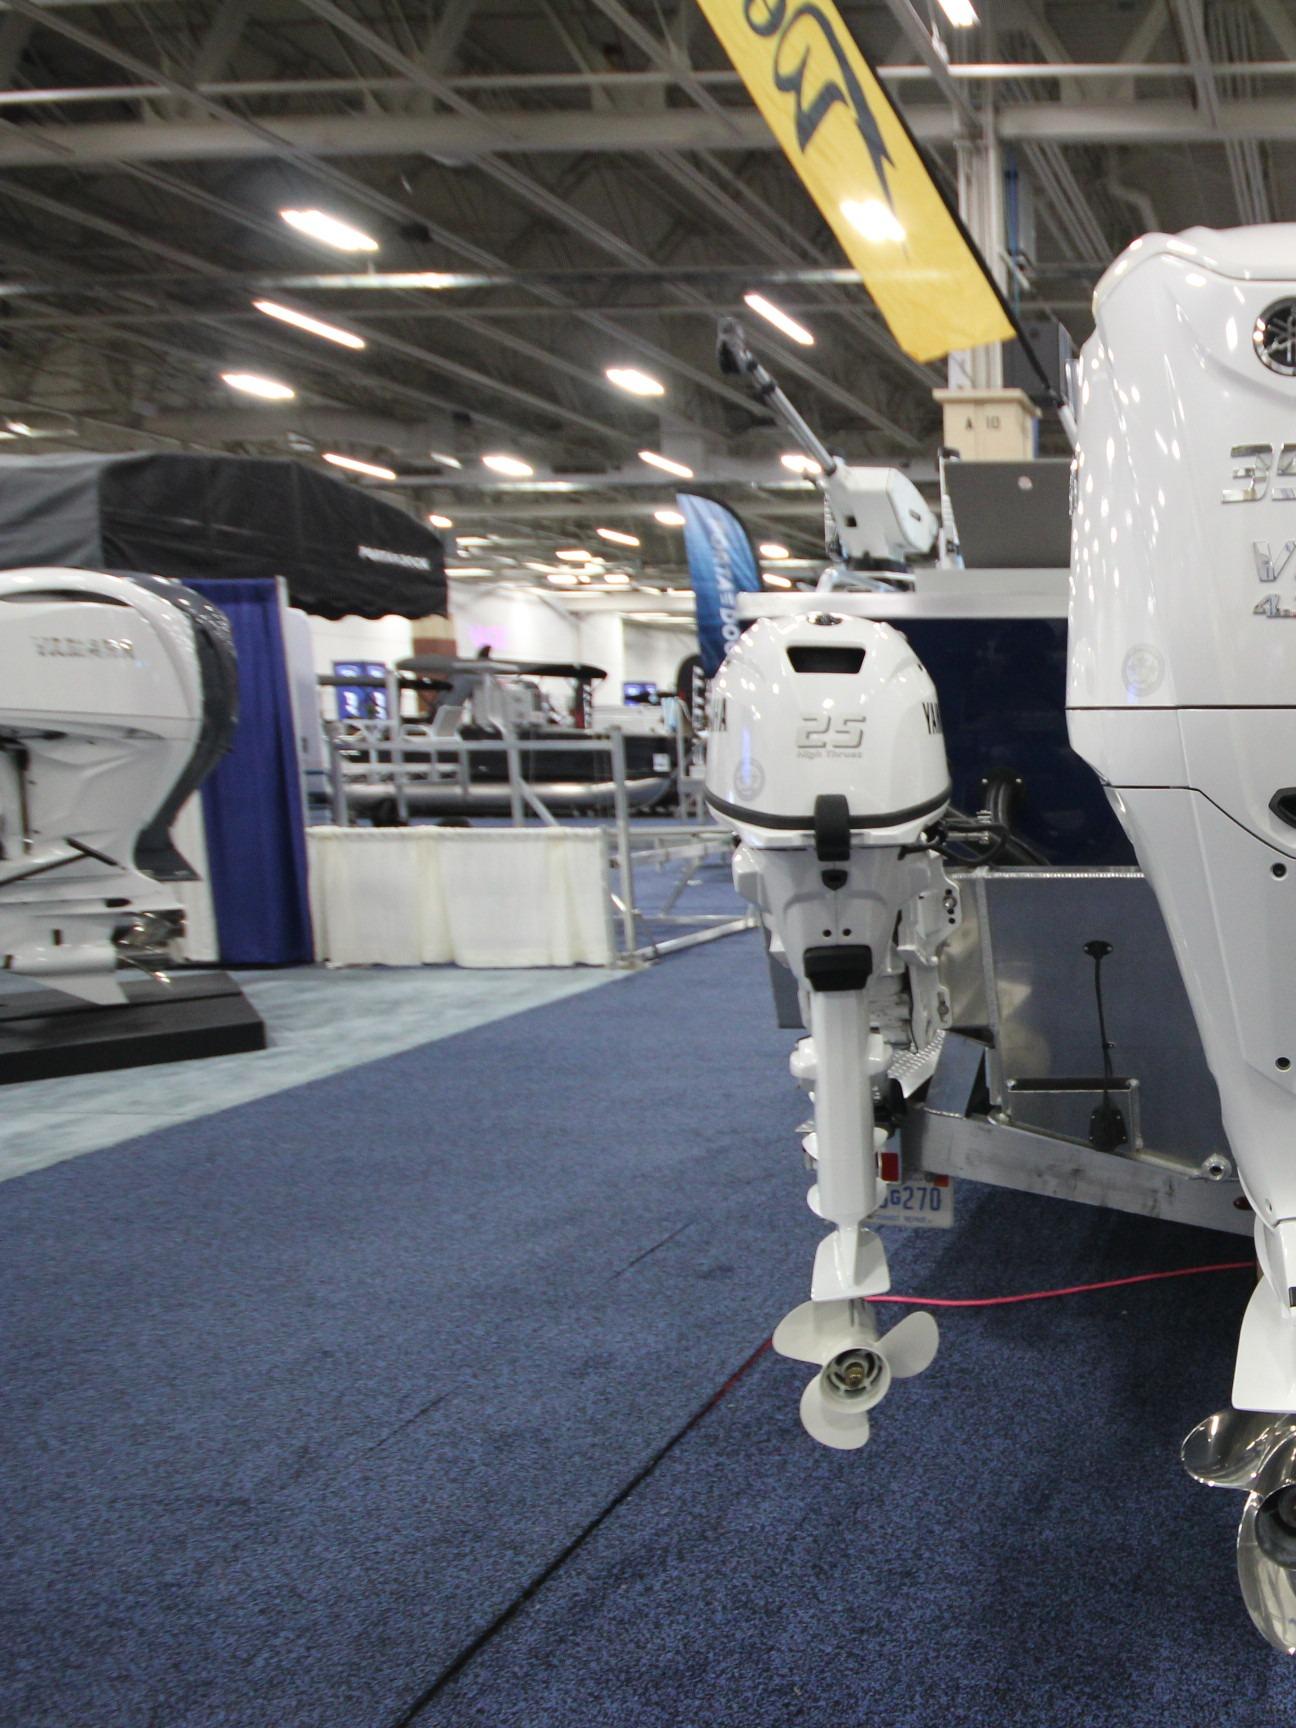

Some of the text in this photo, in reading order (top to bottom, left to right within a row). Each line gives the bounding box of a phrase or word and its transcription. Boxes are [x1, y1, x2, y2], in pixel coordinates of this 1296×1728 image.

[966, 415, 1000, 430] A 10
[796, 713, 866, 748] 25
